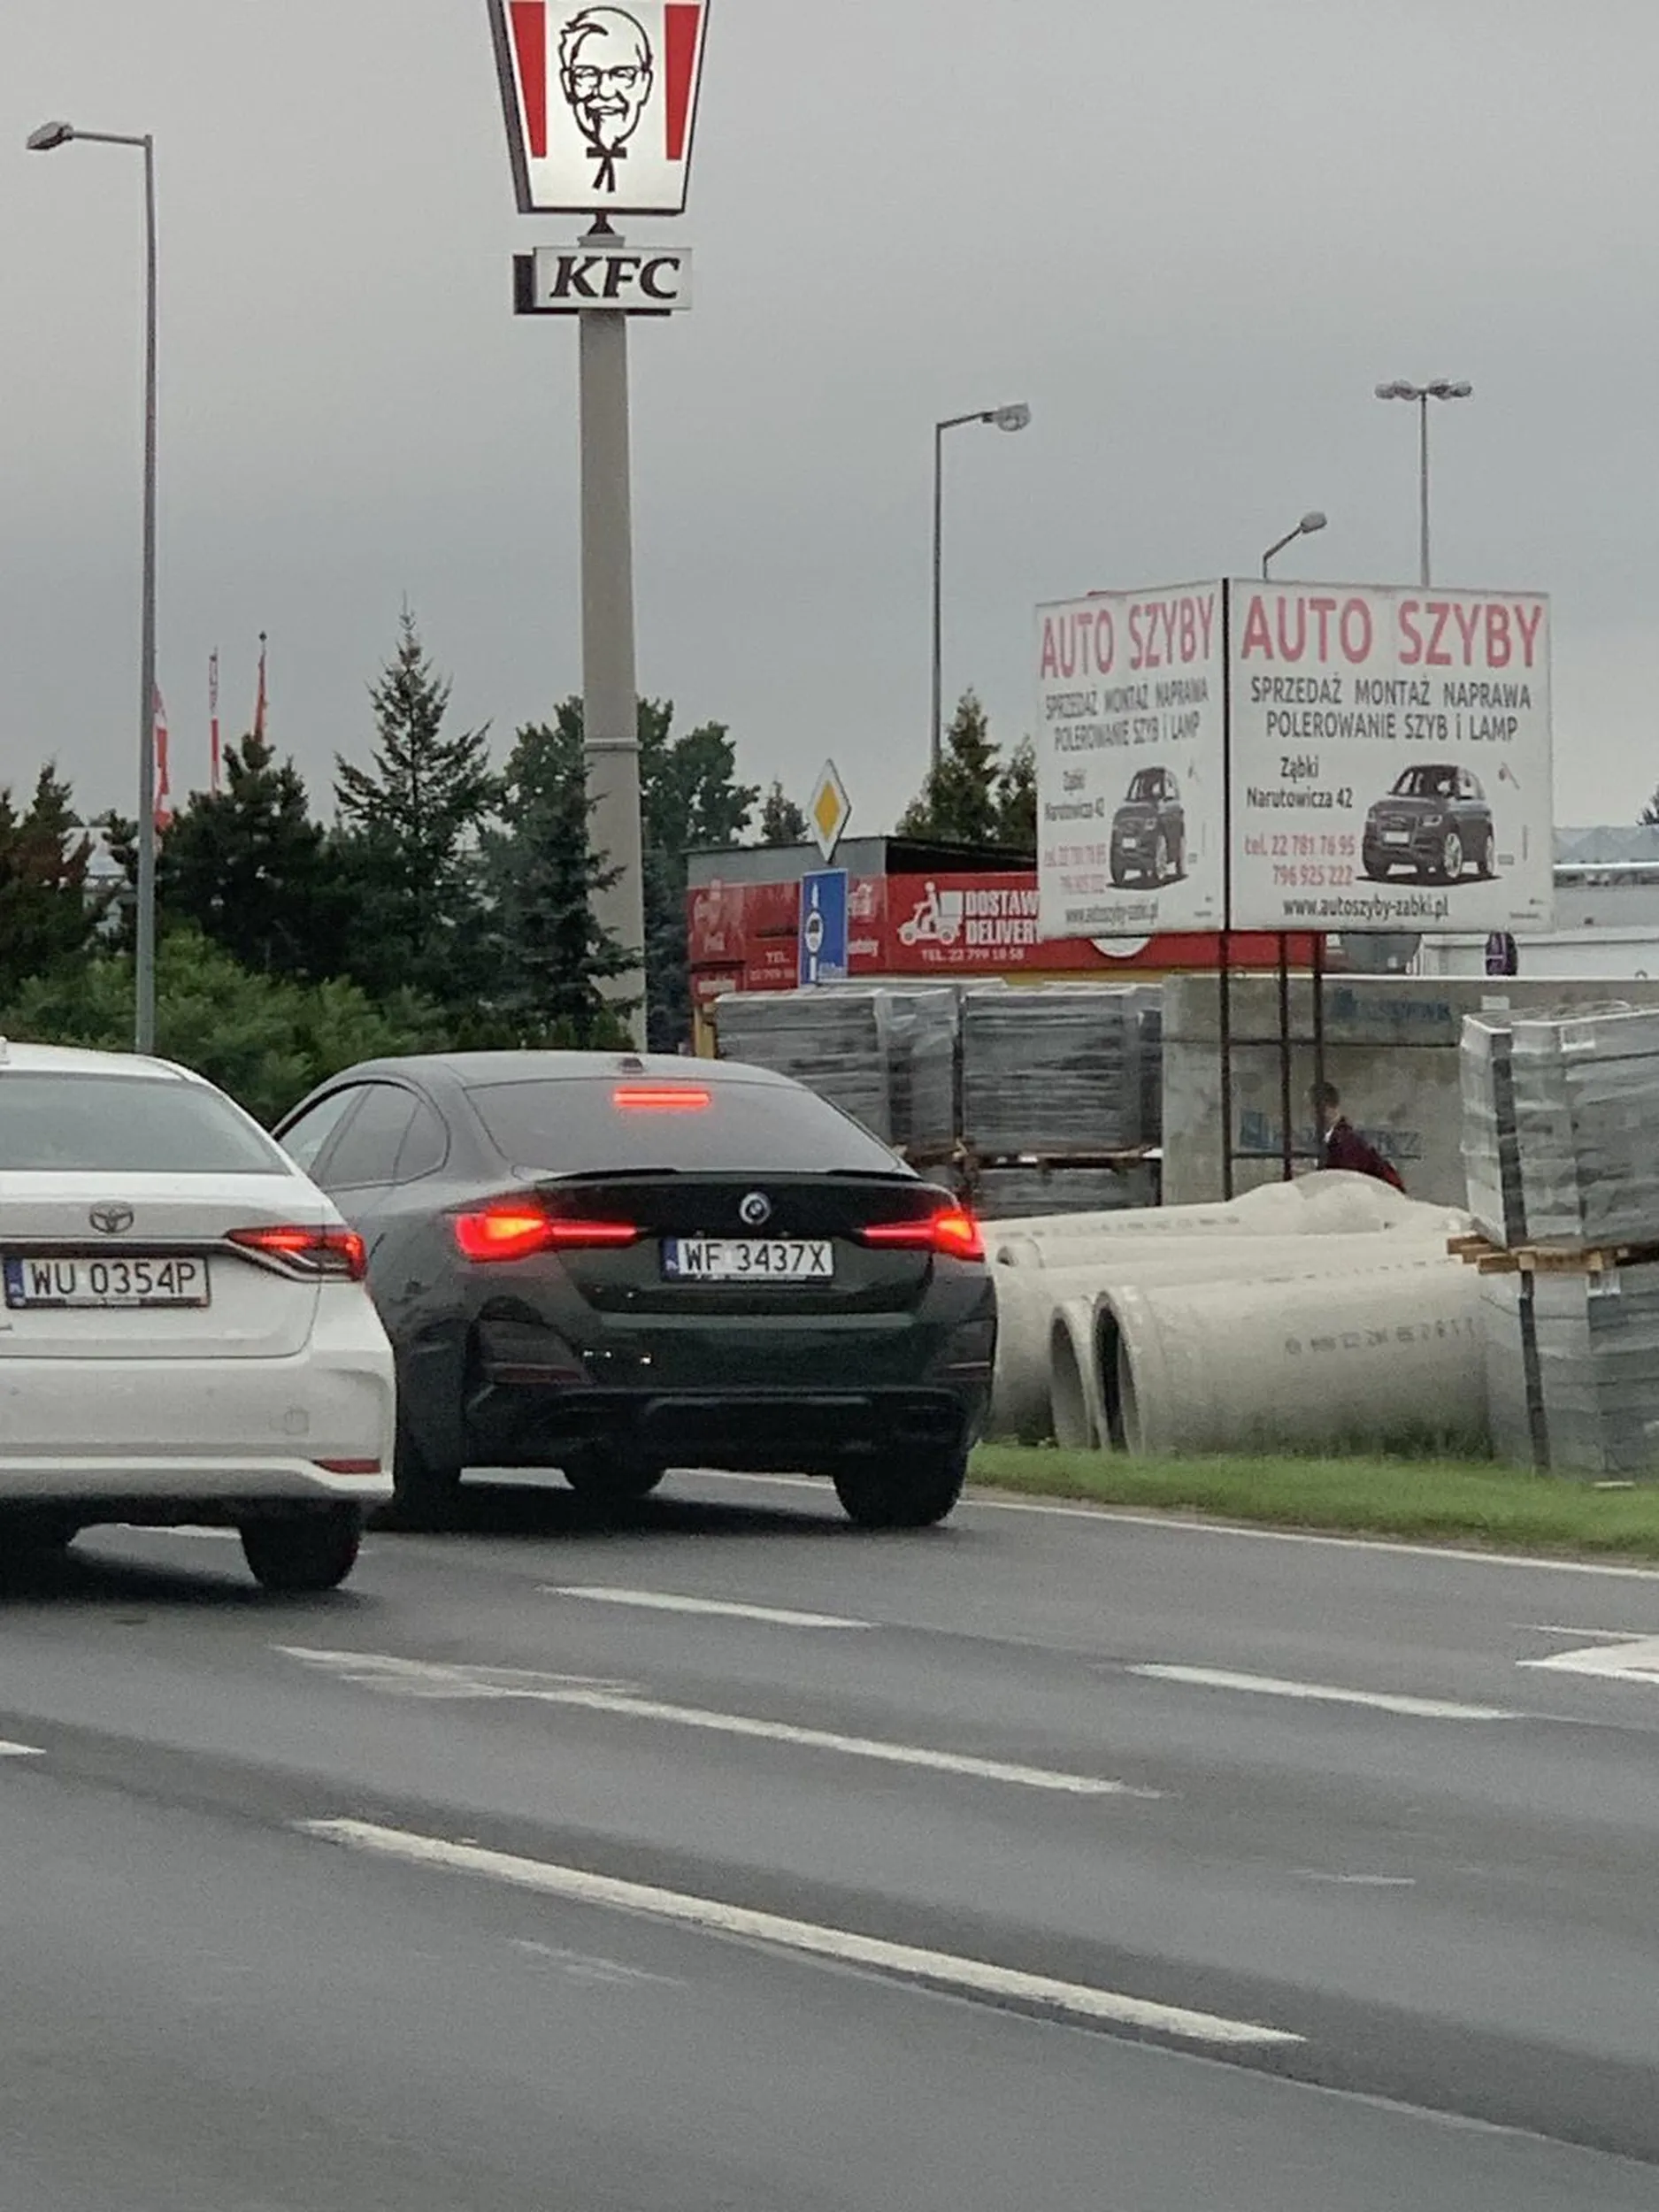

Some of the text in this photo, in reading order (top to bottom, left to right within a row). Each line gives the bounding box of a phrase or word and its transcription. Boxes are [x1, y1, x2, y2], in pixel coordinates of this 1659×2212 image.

[549, 256, 680, 299] KFC
[1041, 593, 1215, 680] AUTO SZYBY
[1240, 595, 1542, 667] AUTO SZYBY
[1251, 672, 1532, 710] SPRZEDAŻ MONTAŻ NAPRAWA
[1267, 710, 1396, 739] POLEROWANIE
[1405, 713, 1448, 741] SZYB
[1470, 715, 1518, 741] LAMP
[1280, 755, 1318, 783] Ząbki
[1247, 786, 1353, 808] Narutowicza 42
[1244, 833, 1268, 856] tel.
[1271, 835, 1287, 856] 22
[964, 891, 1039, 917] DOSTAW
[1283, 894, 1449, 921] www.autoszyby-zabki.pl
[685, 1243, 826, 1272] WF 3437X
[31, 1262, 196, 1294] WU 0354P
